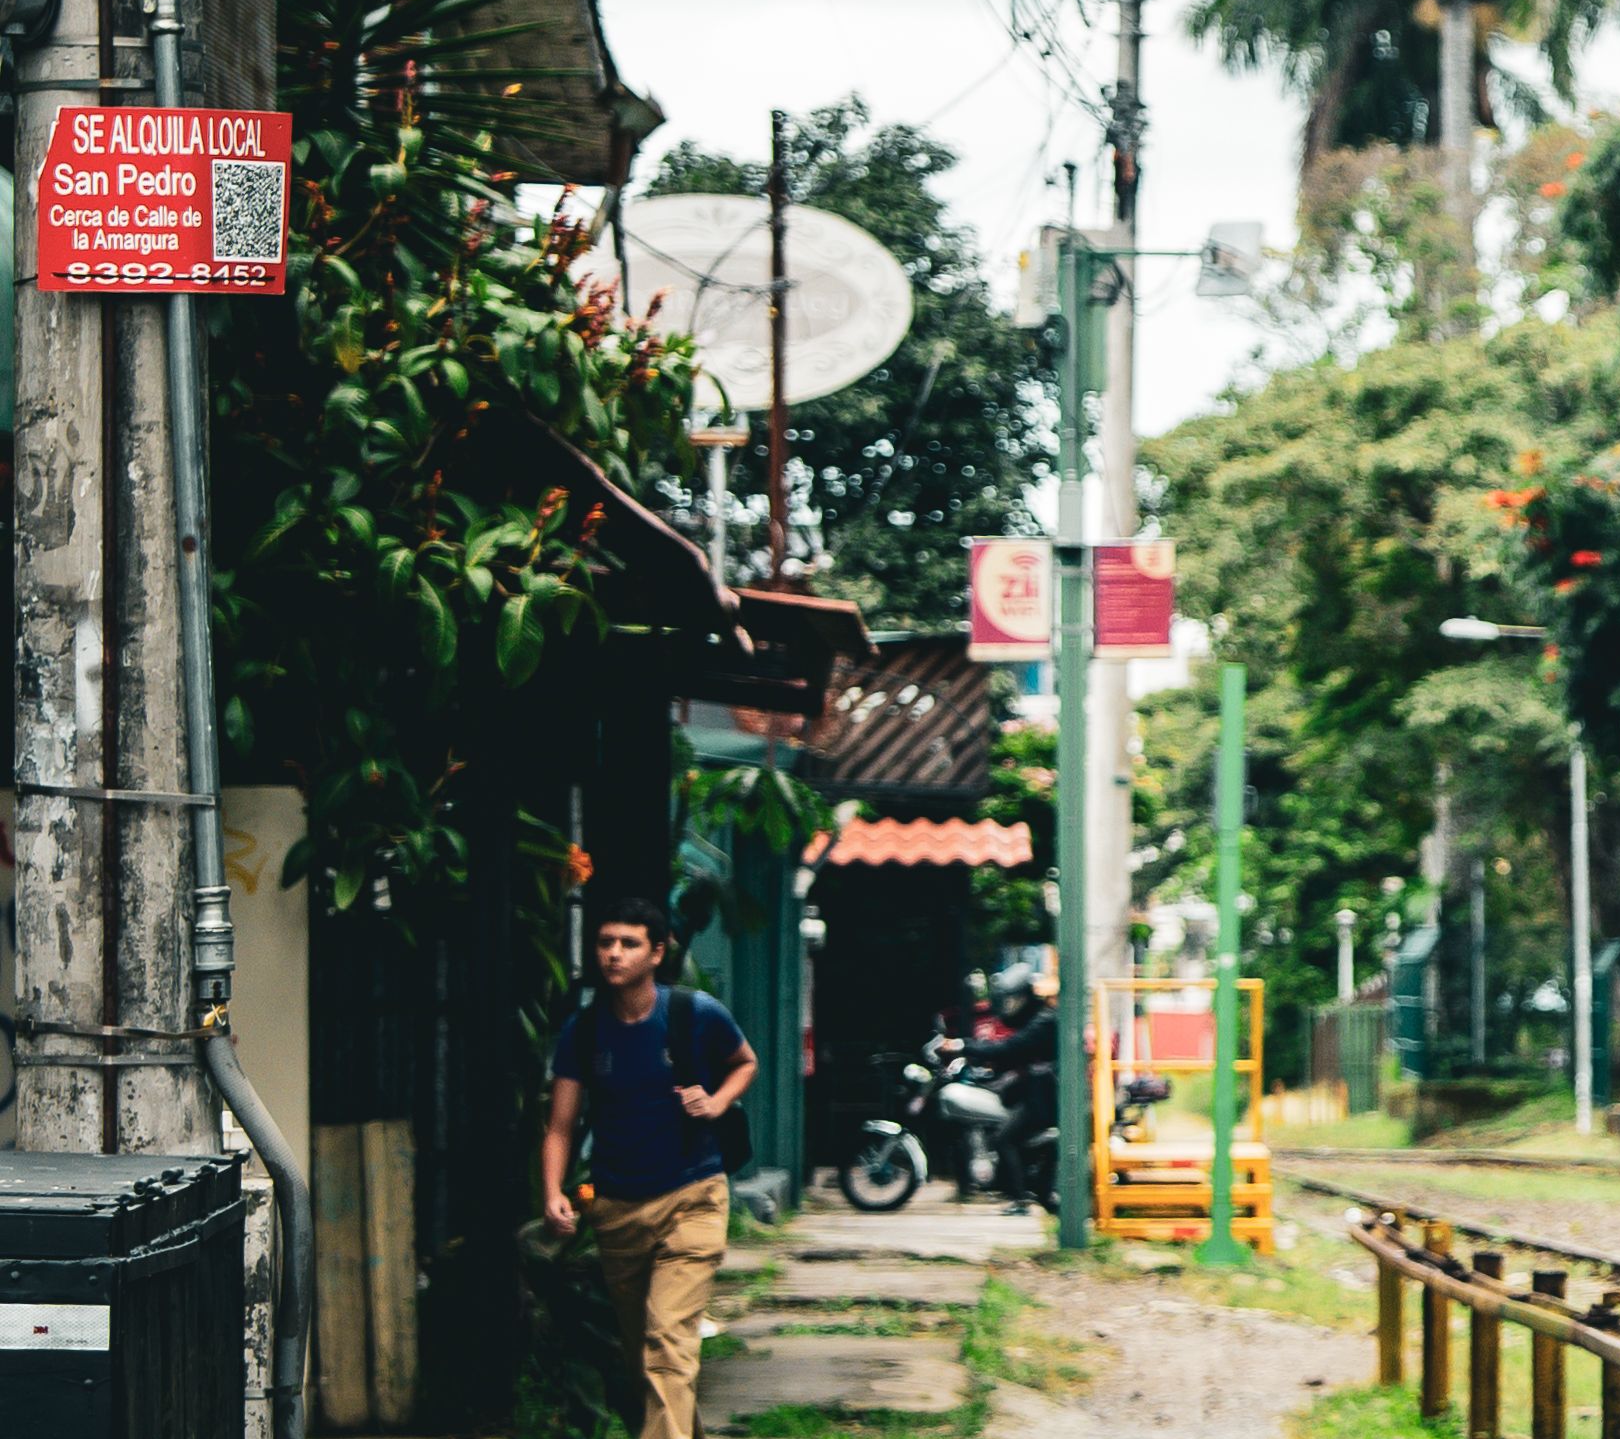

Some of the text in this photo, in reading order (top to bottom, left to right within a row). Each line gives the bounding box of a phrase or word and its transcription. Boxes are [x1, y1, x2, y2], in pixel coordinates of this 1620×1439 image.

[73, 114, 266, 157] SE ALQUILA LOCAL
[53, 163, 197, 197] San Pedro
[50, 205, 202, 228] Cerca de Calle de
[72, 228, 180, 255] la Amargura
[66, 262, 267, 286] 8392-8452
